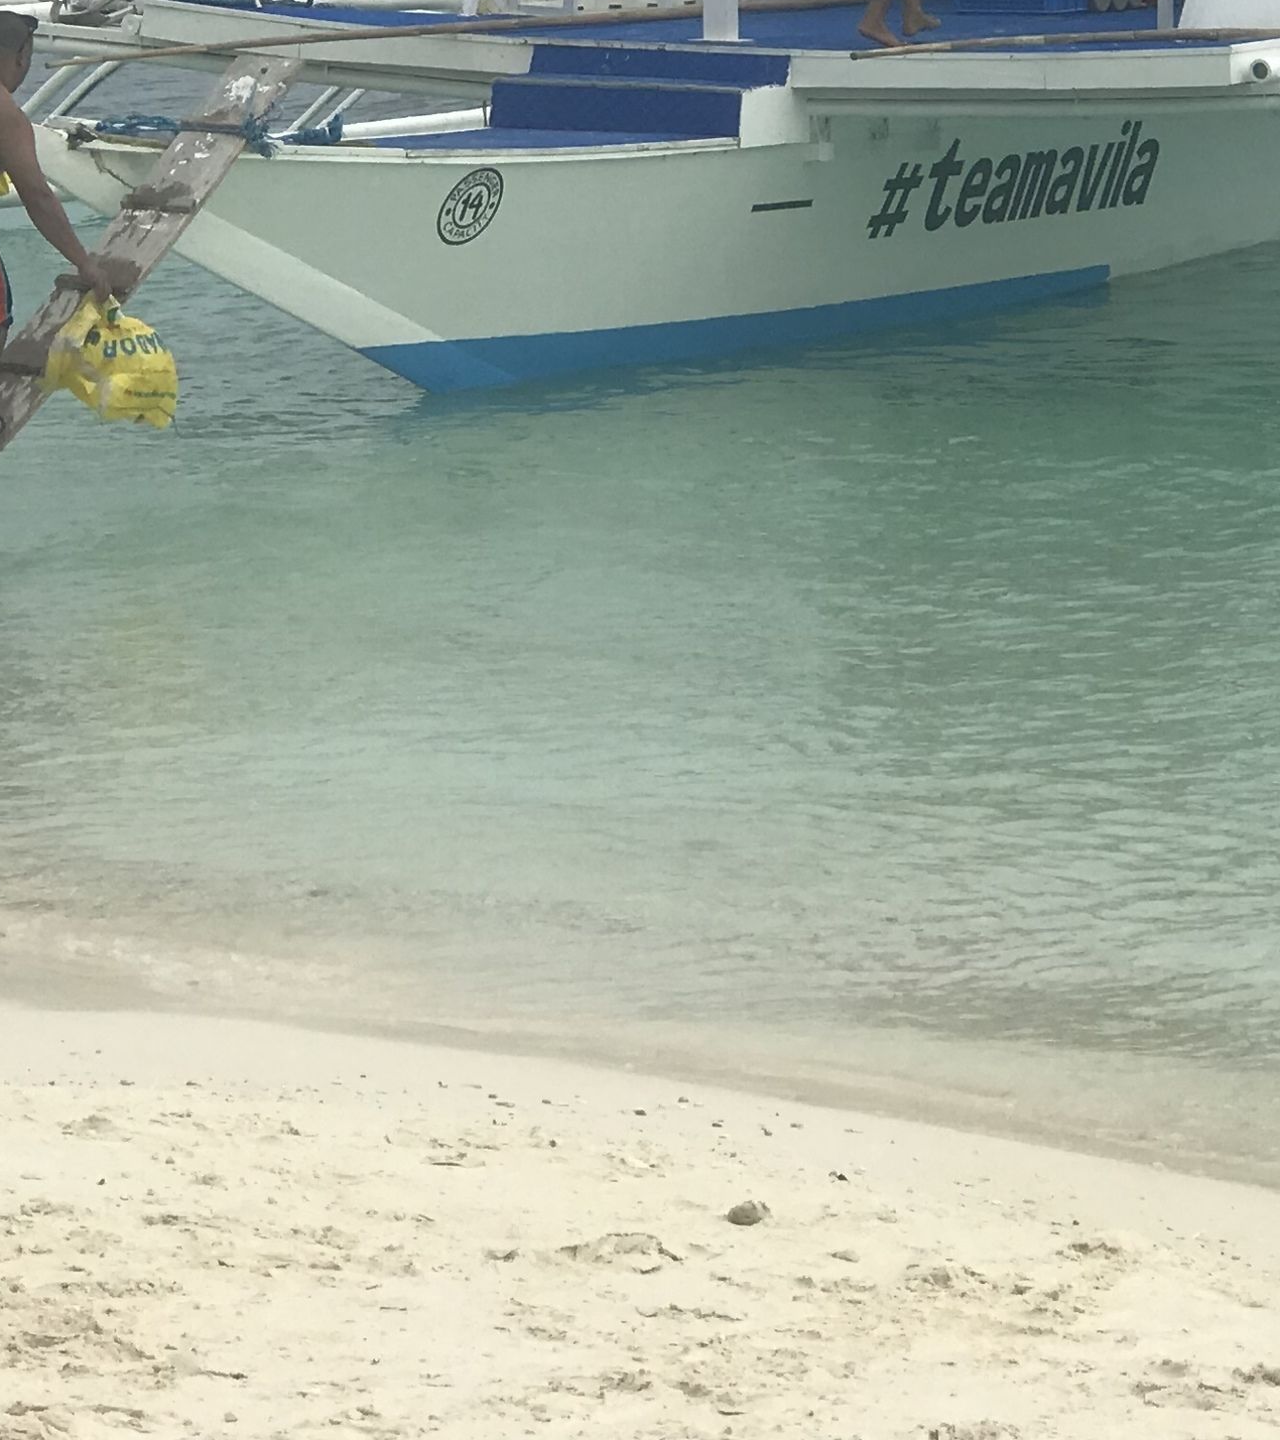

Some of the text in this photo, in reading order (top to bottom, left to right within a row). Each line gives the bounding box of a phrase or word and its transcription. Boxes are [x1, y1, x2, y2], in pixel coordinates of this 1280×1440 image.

[449, 172, 500, 201] PASSENGER
[866, 120, 1160, 239] #teamavila
[458, 190, 484, 222] 14
[443, 214, 489, 239] CAPACITY
